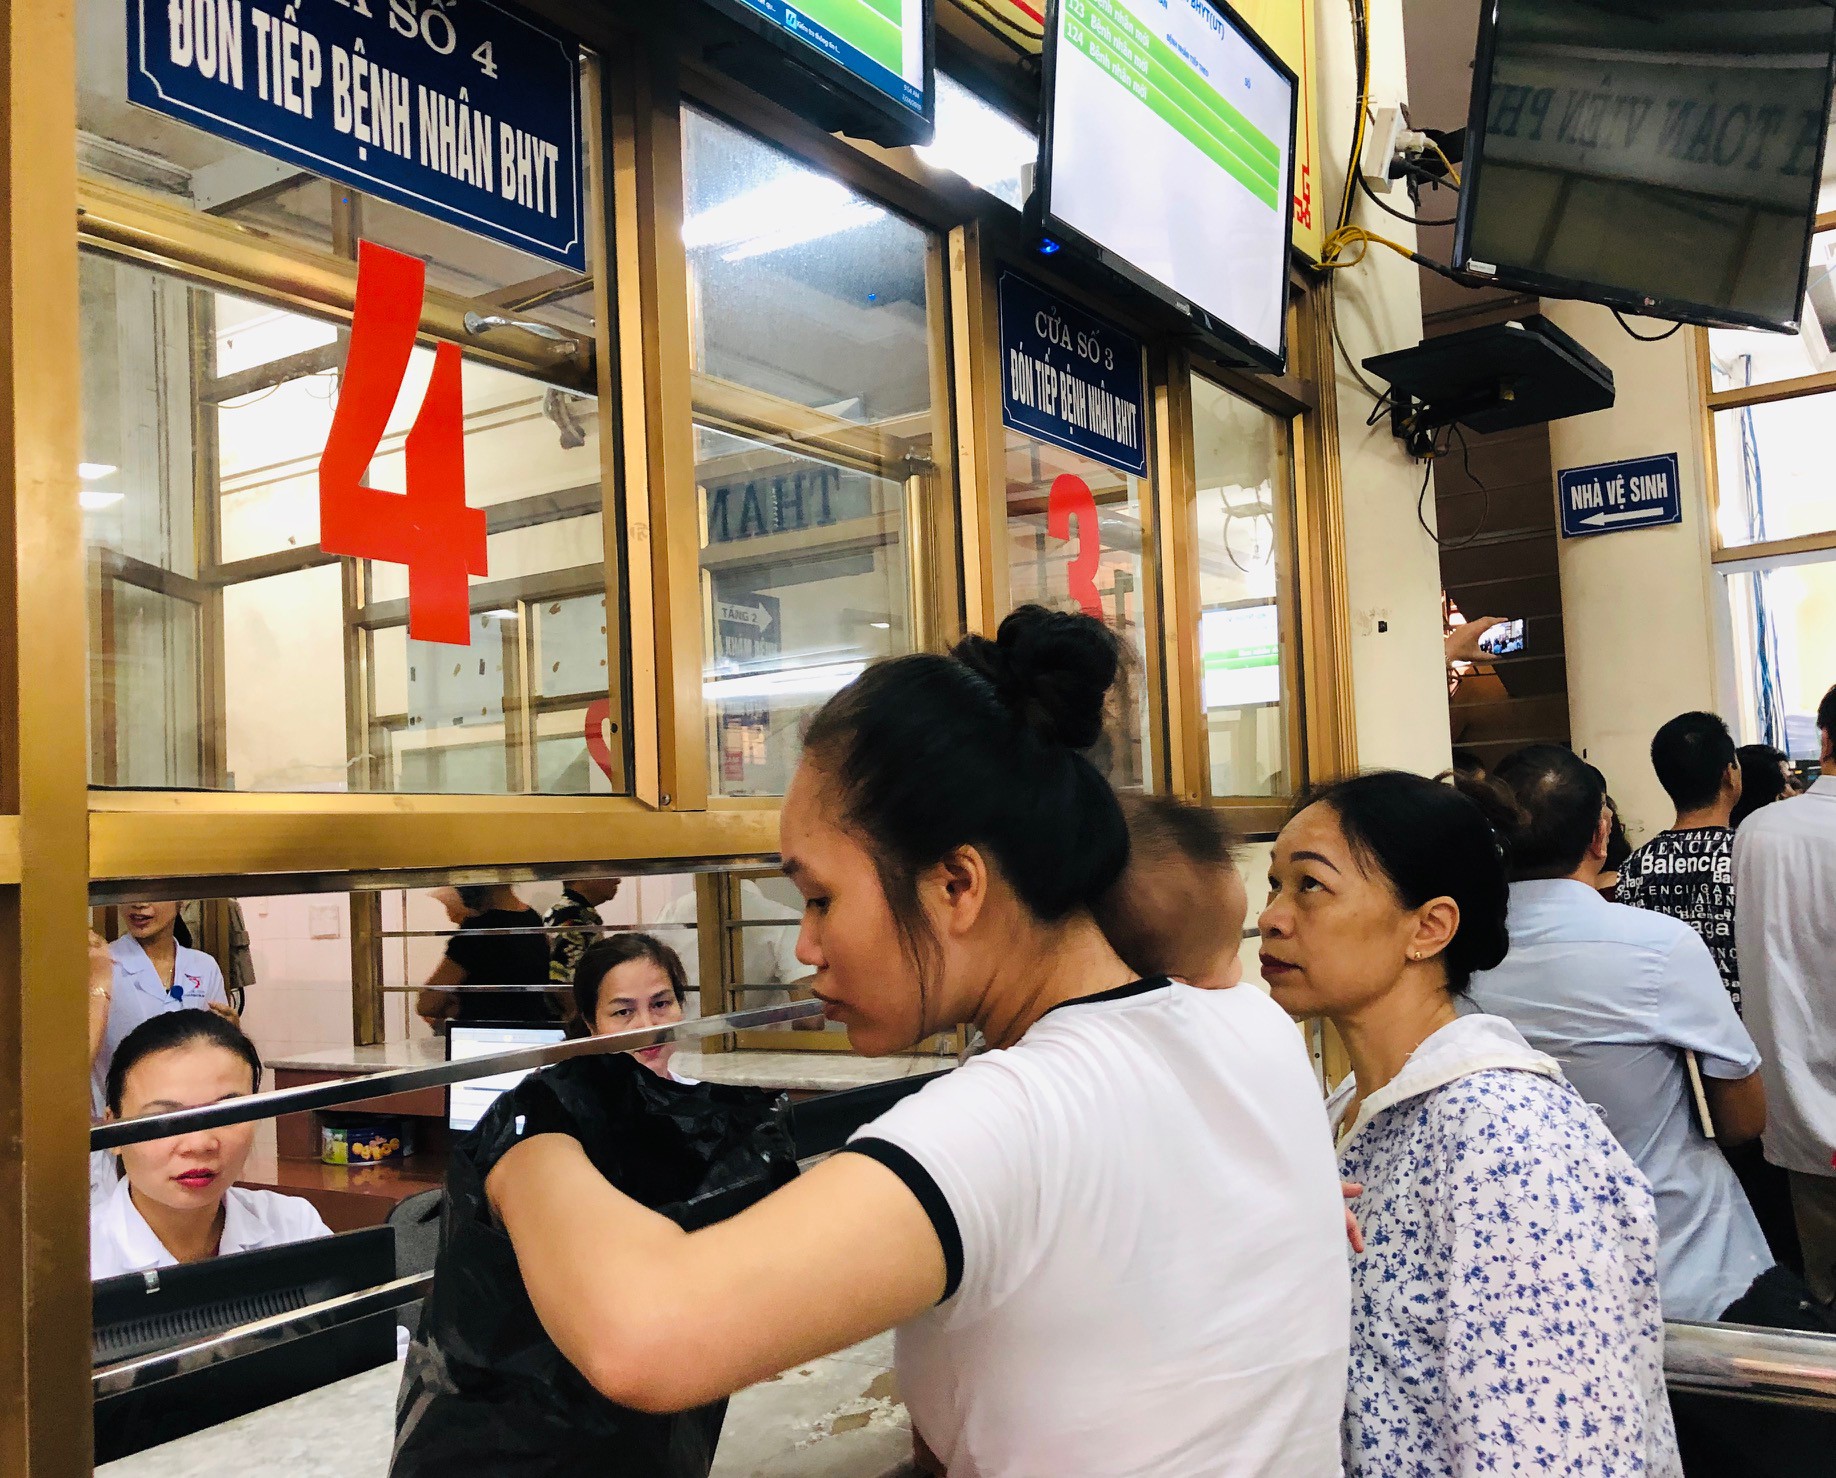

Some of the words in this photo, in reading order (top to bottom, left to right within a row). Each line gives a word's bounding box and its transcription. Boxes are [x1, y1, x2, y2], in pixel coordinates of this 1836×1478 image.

[1068, 0, 1085, 18] 123
[1067, 22, 1083, 47] 124
[471, 41, 498, 79] 4
[252, 0, 323, 119] TIẾP
[332, 37, 412, 162] BỆNH
[418, 86, 494, 194] NHÂN
[500, 121, 559, 219] BHYT
[1035, 305, 1074, 351] CỬA
[1077, 329, 1101, 364] SỐ
[1104, 347, 1114, 371] 3
[1010, 341, 1035, 408] ĐÓN
[1035, 347, 1058, 417] TIẾP
[1059, 363, 1087, 435] BỆNH
[1087, 380, 1115, 441] NHÂN
[1115, 396, 1138, 450] BHYT
[319, 237, 489, 646] 4
[1570, 477, 1604, 511] NHÀ
[1606, 473, 1626, 510] VỆ
[1629, 472, 1668, 502] SINH
[1048, 473, 1104, 623] 3
[751, 613, 758, 623] 2
[1641, 853, 1731, 875] Balencia
